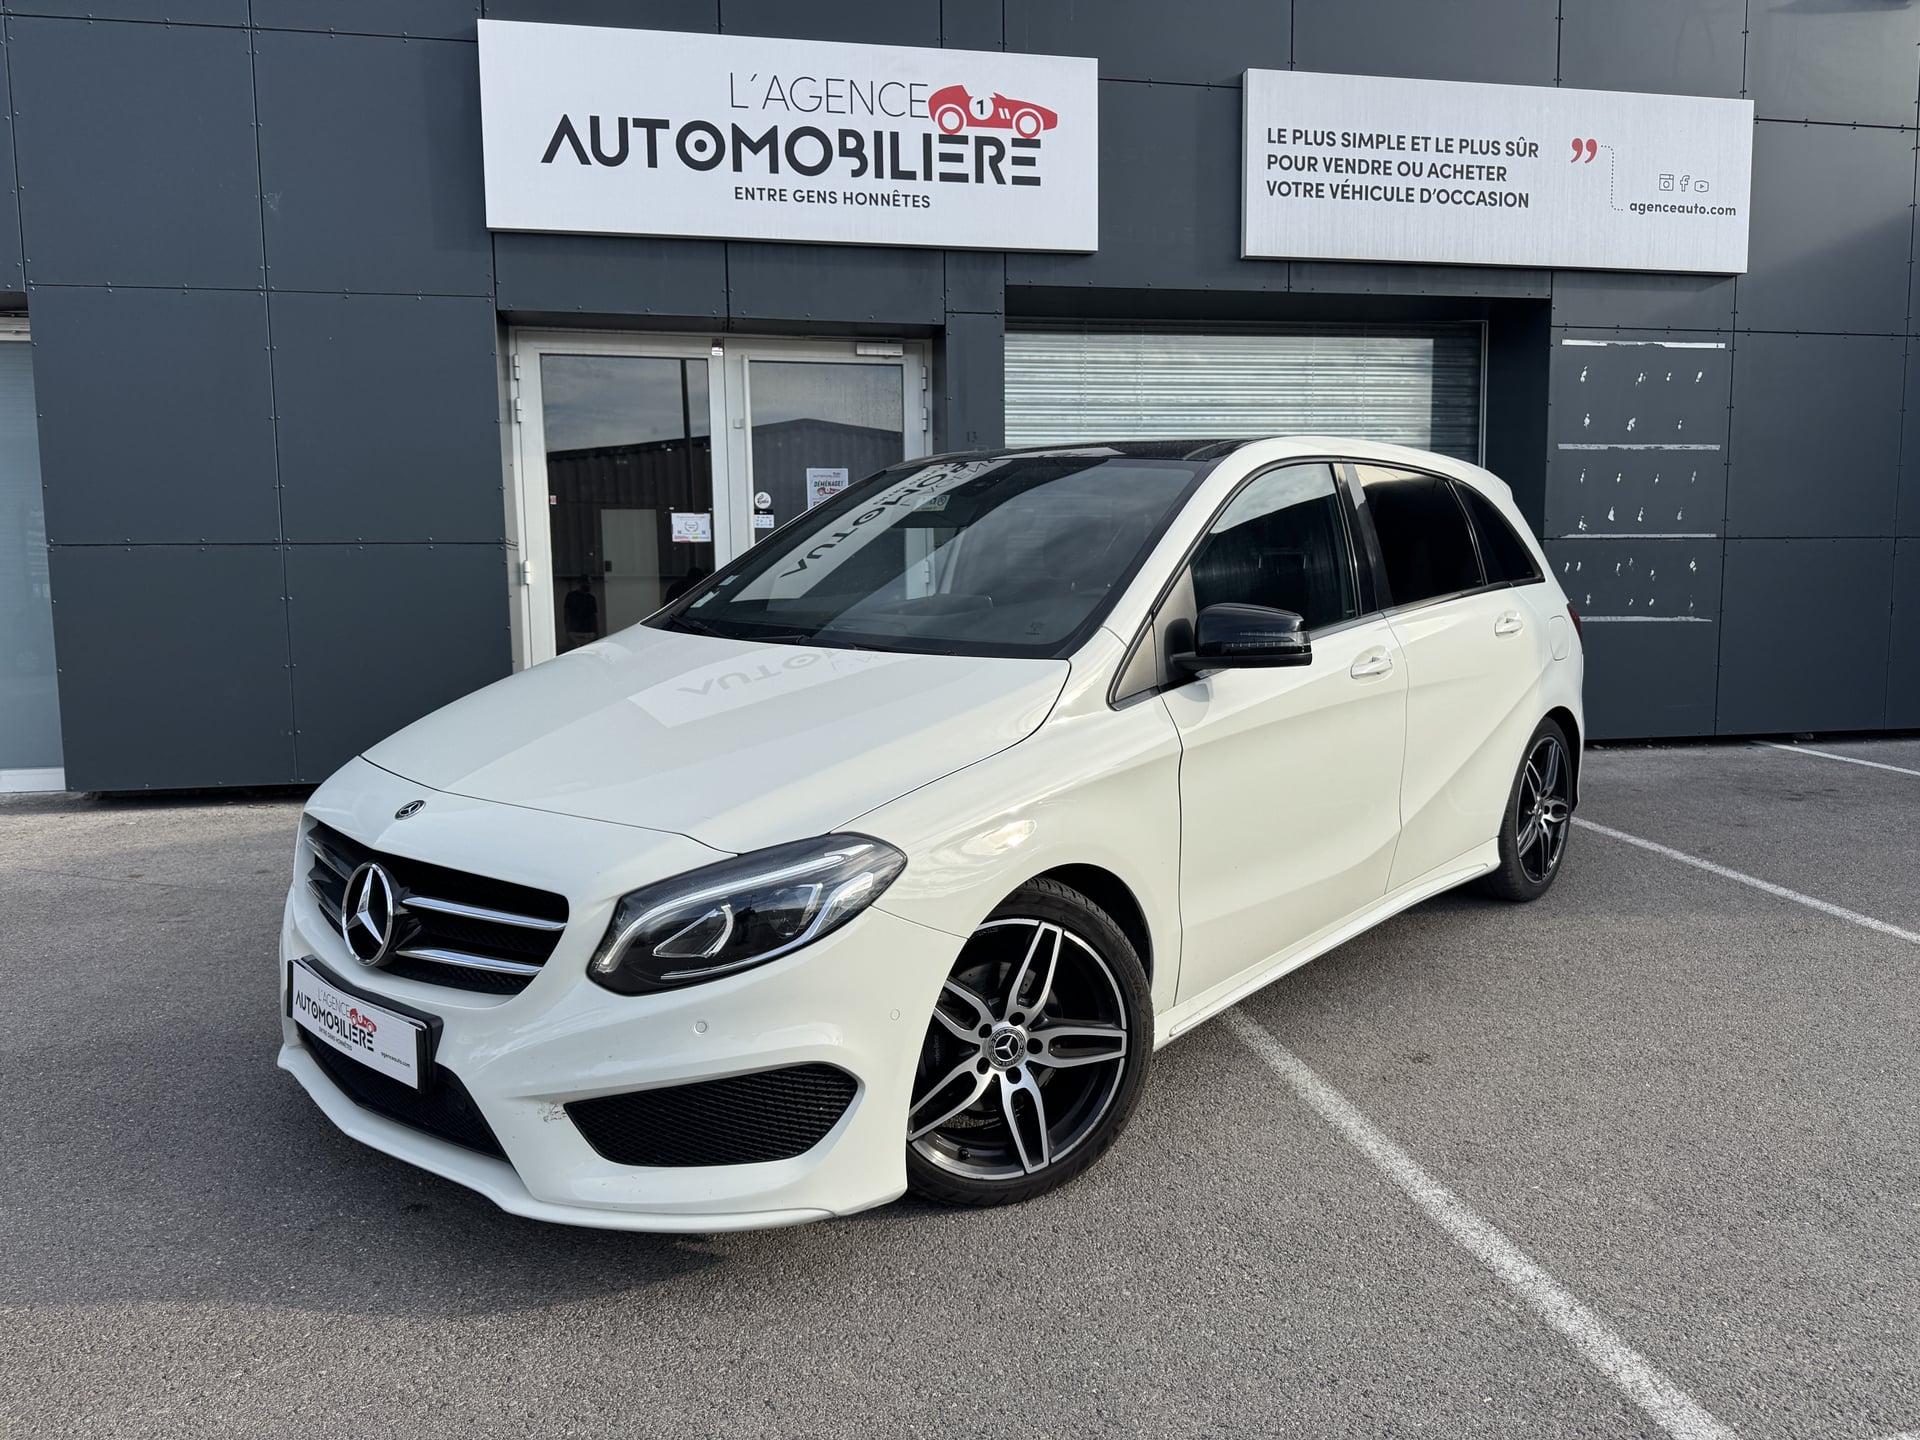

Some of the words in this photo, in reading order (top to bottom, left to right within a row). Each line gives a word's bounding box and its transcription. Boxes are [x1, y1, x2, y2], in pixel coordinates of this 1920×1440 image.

[730, 71, 929, 118] L'AGENCE
[1267, 127, 1287, 145] LE
[1292, 129, 1337, 147] PLUS
[1340, 131, 1406, 151] SIMPLE
[1411, 135, 1432, 152] ET
[1435, 136, 1454, 154] LE
[1458, 138, 1501, 156] PLUS
[1505, 136, 1539, 158] SÛR
[1267, 153, 1318, 173] POUR
[1322, 157, 1393, 177] VENDRE
[1396, 160, 1424, 178] OU
[1427, 162, 1507, 182] ACHETER
[734, 186, 788, 202] ENTRE
[792, 189, 838, 205] GENS
[843, 189, 930, 208] HONNÊTES
[1266, 180, 1325, 200] VOTRE
[1328, 178, 1415, 203] VÉHICULE
[1419, 187, 1529, 208] D'OCCASION
[1629, 200, 1737, 216] agenceauto.com
